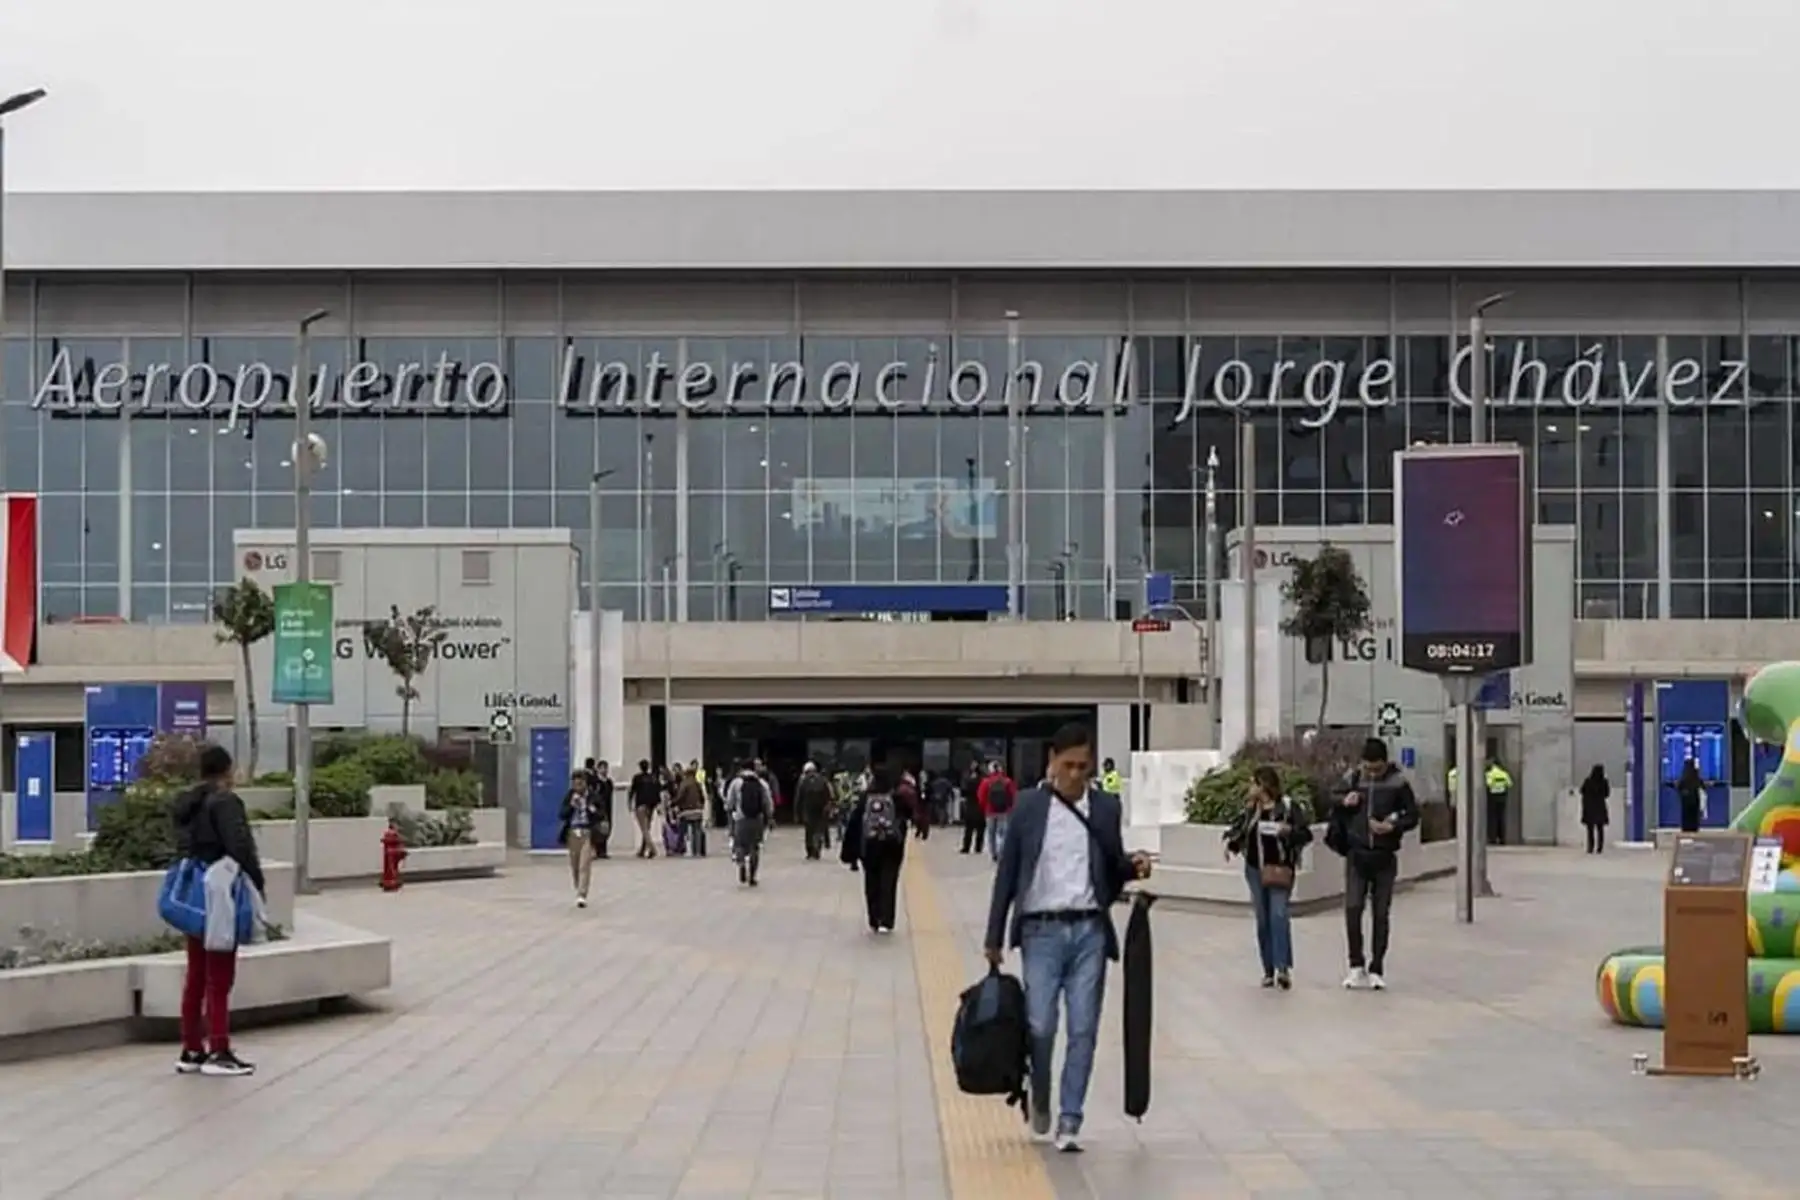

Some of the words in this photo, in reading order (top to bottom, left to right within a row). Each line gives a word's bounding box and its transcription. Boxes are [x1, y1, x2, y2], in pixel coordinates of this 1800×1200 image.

[32, 345, 505, 429] Aeropuerto
[558, 337, 1131, 408] Internacional
[1175, 344, 1395, 427] Jorge
[1449, 340, 1747, 405] Chávez
[265, 554, 287, 569] LG
[1272, 552, 1291, 566] LG
[1342, 637, 1376, 661] LG
